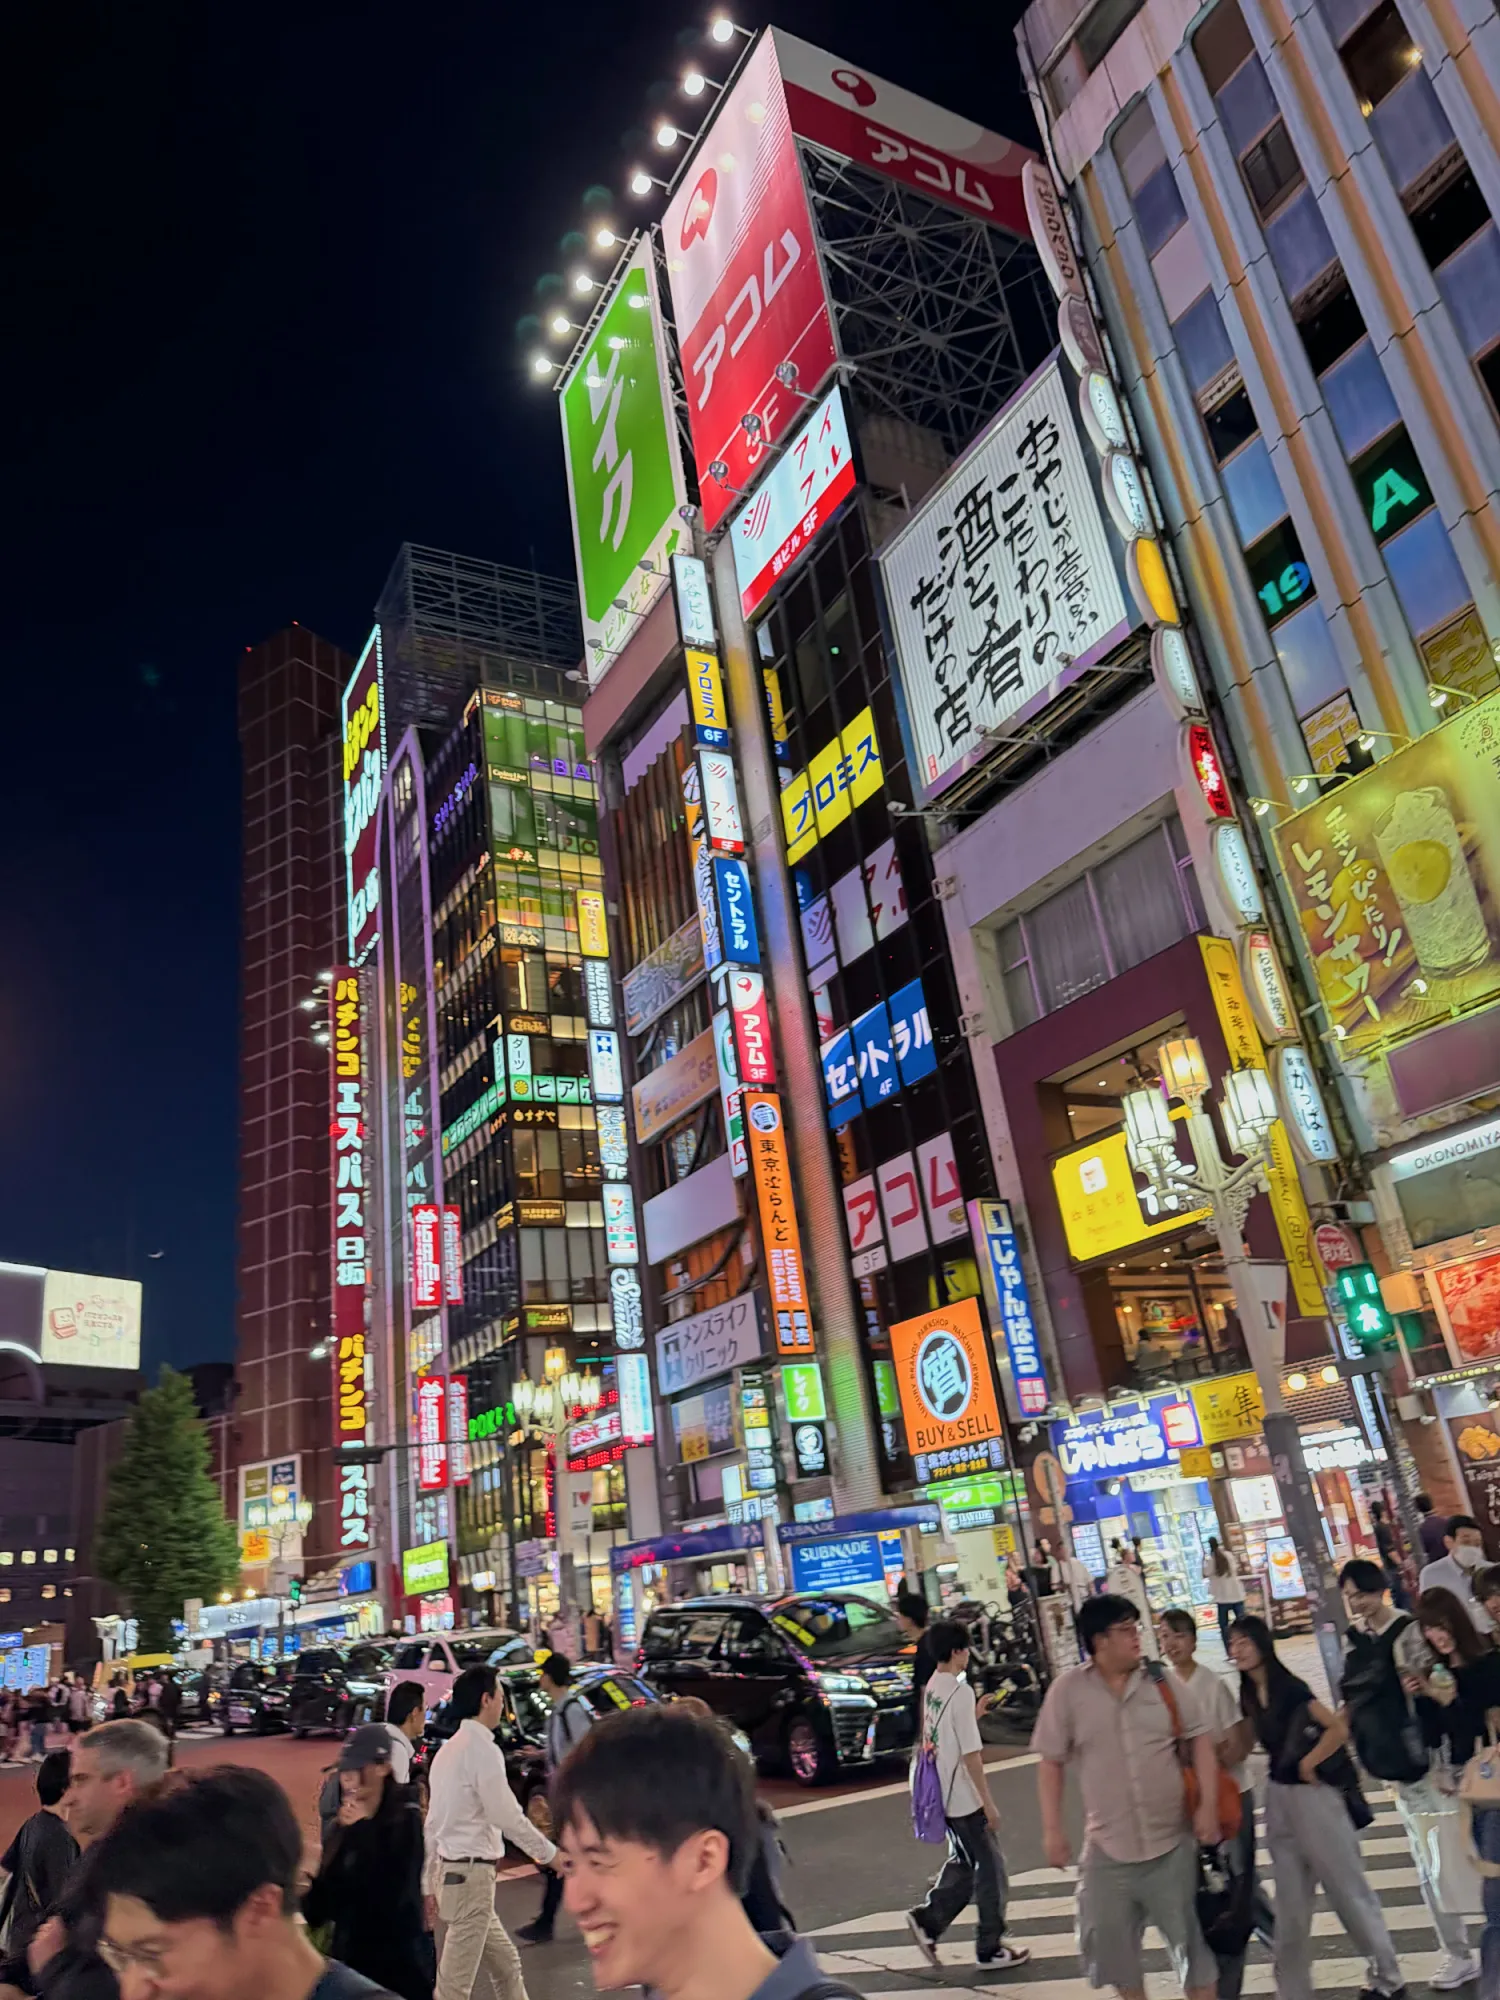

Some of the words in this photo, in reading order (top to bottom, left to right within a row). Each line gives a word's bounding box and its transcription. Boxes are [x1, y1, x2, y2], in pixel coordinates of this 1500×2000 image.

[866, 127, 993, 211] アコム
[693, 228, 800, 410] アコム
[772, 532, 801, 577] 当ビル
[802, 507, 820, 540] 5F
[683, 565, 705, 631] 戸谷ビル
[697, 661, 717, 721] プロミス
[910, 564, 973, 758] だけの店
[704, 728, 723, 742] 6F
[791, 734, 881, 832] プロミス
[724, 871, 749, 951] セントラル
[1292, 842, 1381, 1022] レモンサワー
[335, 978, 360, 1076] パチンコ
[513, 1038, 526, 1071] ダーツ
[742, 1014, 767, 1065] アコム
[825, 1006, 933, 1100] セントラル
[750, 1068, 768, 1081] 3F
[879, 1077, 894, 1096] 4F
[848, 1155, 963, 1249] アコム
[421, 1225, 441, 1301] GAME
[770, 1249, 789, 1303] RESALE
[783, 1249, 803, 1303] LUXURY
[864, 1252, 881, 1270] 3F
[683, 1303, 747, 1350] メンズライフ
[686, 1340, 738, 1379] クリニック
[339, 1334, 366, 1430] パチンコ
[340, 1440, 369, 1546] スパス
[781, 1520, 836, 1539] SUBNADE
[799, 1539, 872, 1563] SUBNADE
